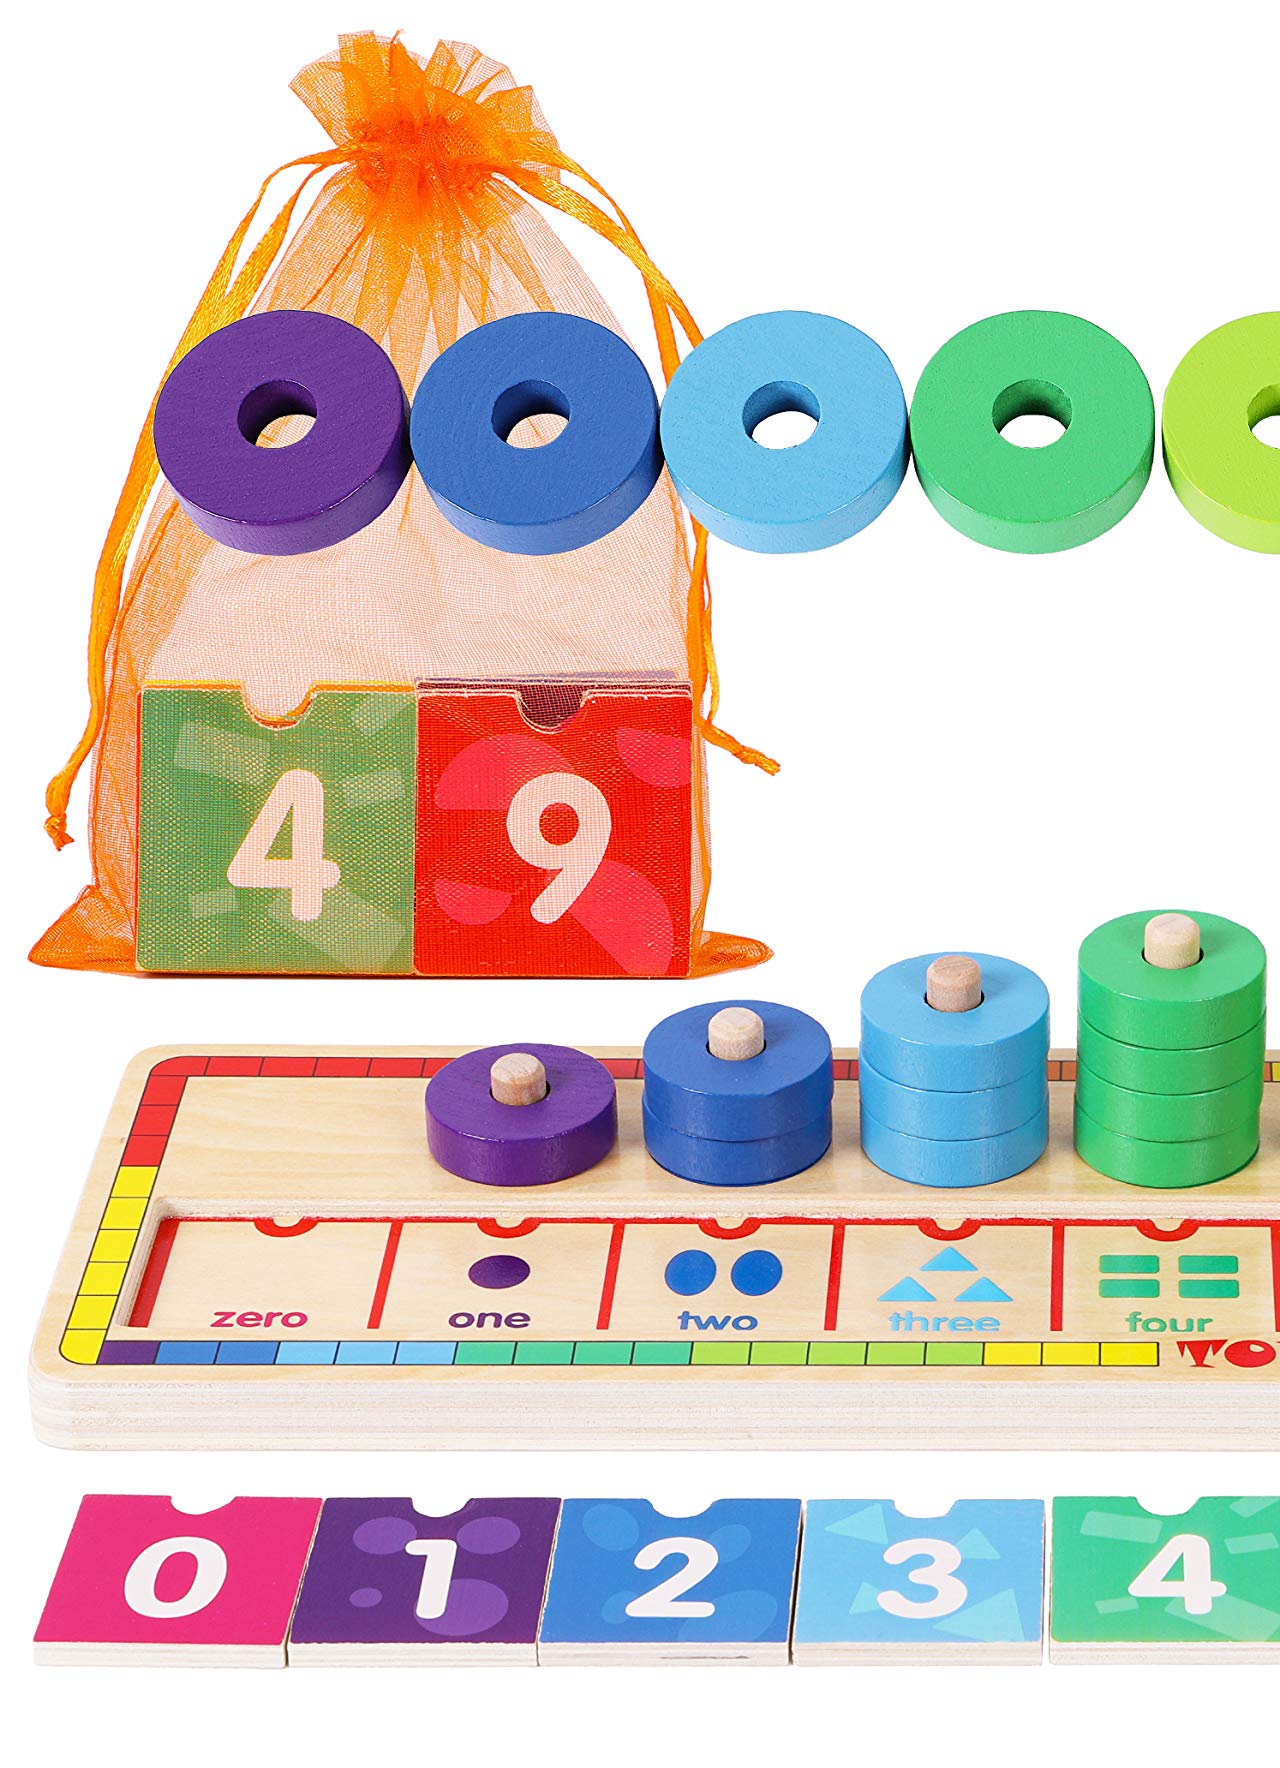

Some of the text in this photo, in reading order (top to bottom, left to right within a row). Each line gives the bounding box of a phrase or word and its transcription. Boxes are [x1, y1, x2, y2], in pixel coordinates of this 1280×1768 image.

[227, 769, 340, 921] 4
[507, 772, 611, 924] 9
[210, 1310, 308, 1329] zero
[448, 1310, 531, 1329] one
[677, 1310, 758, 1331] two
[888, 1310, 1001, 1333] three
[1125, 1311, 1213, 1333] four
[124, 1537, 227, 1619] 0
[405, 1539, 458, 1619] 1
[625, 1539, 718, 1617] 2
[876, 1539, 968, 1619] 3
[1128, 1534, 1226, 1614] 4
